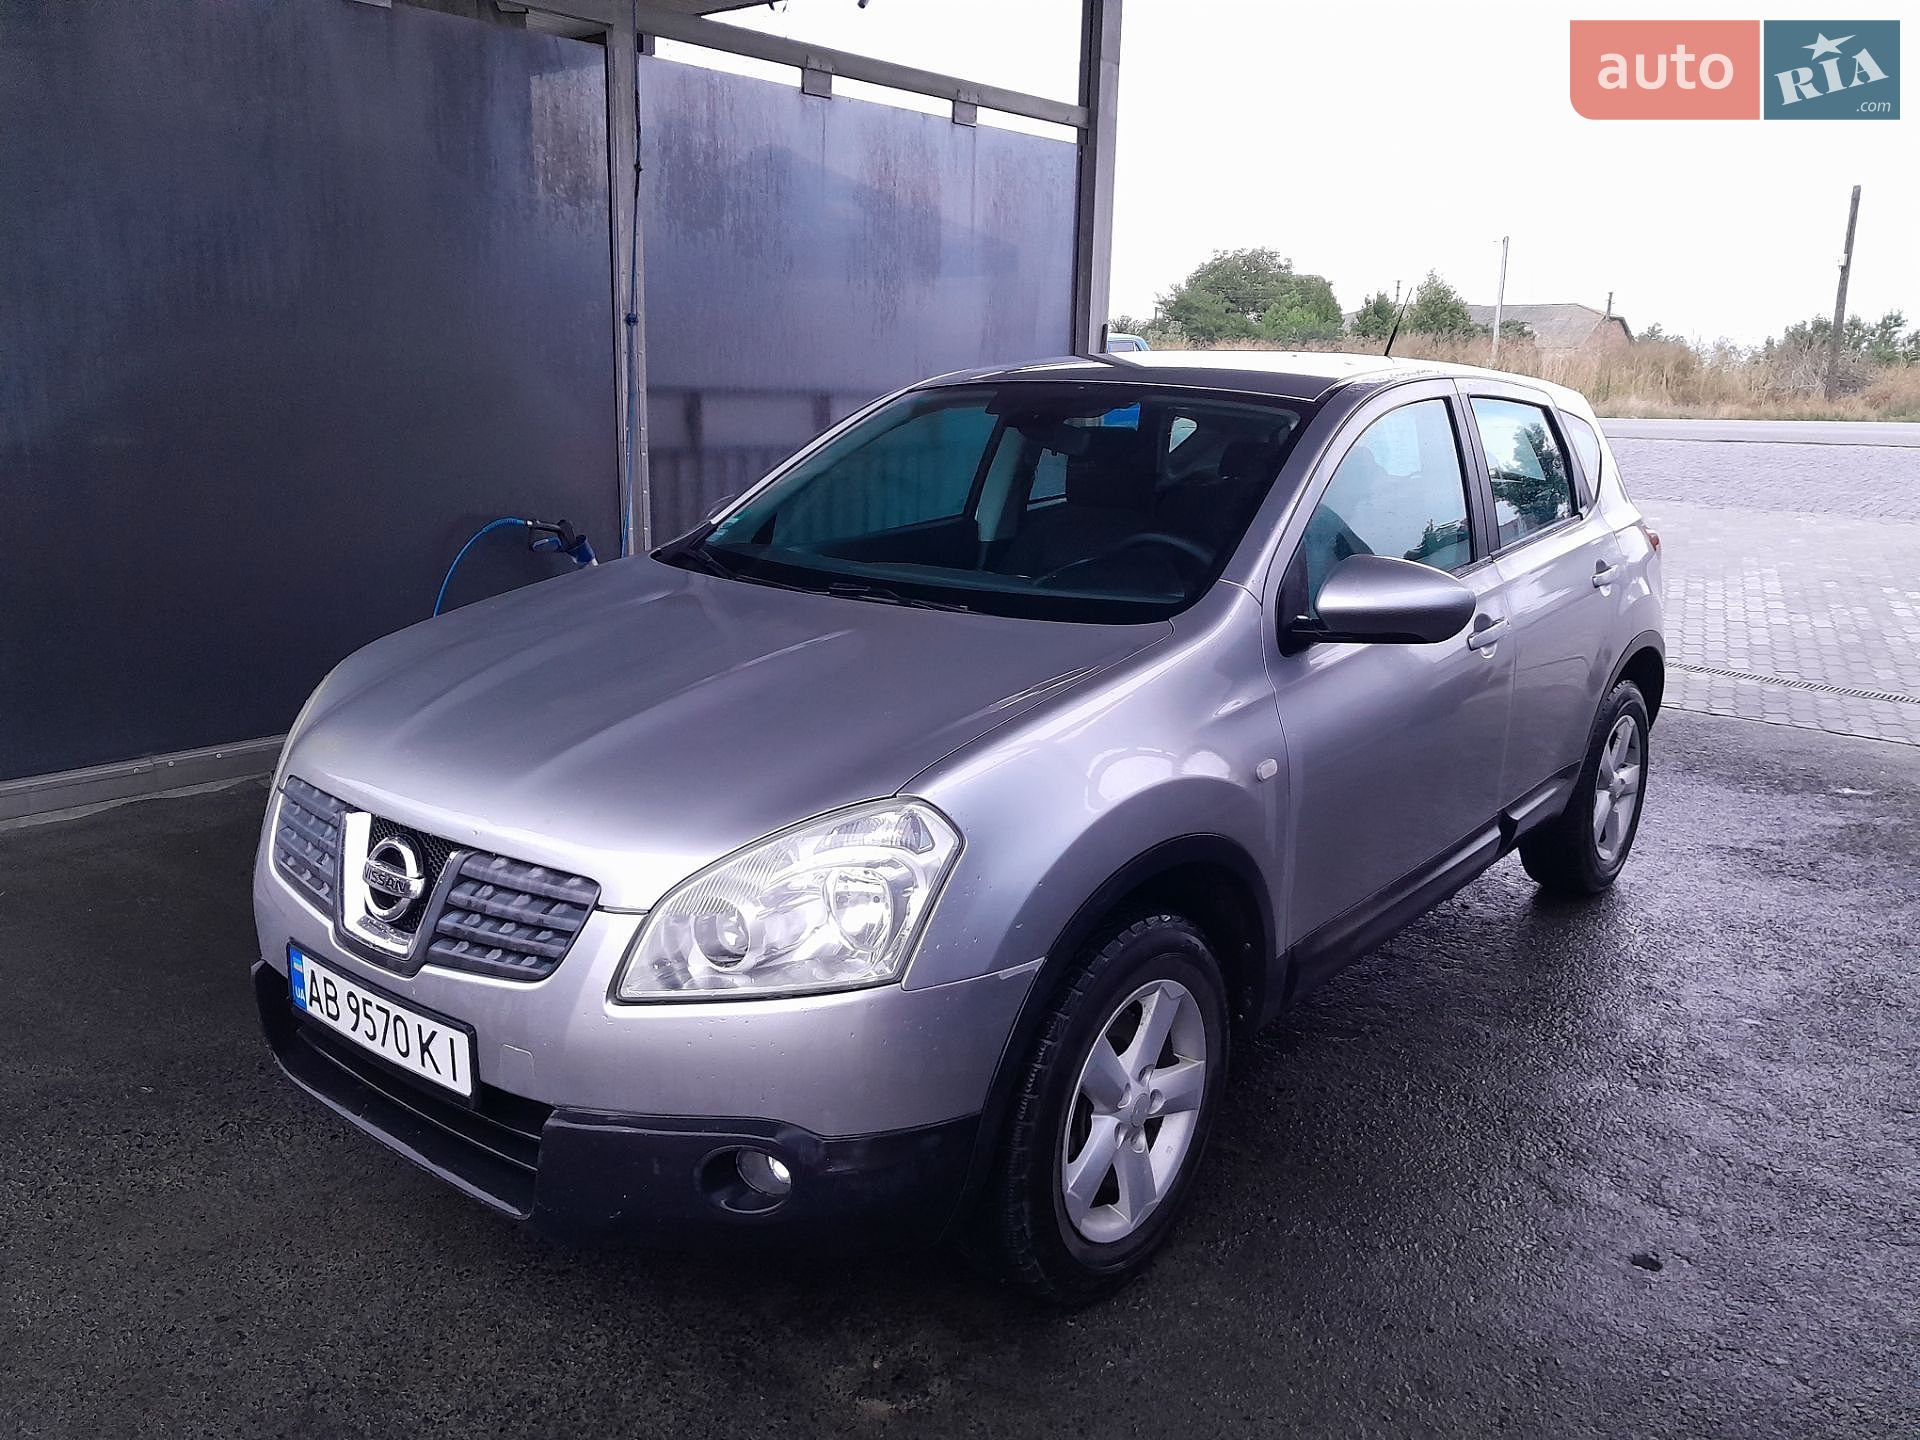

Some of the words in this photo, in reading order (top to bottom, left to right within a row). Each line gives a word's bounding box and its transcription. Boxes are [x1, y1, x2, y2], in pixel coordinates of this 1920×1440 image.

[364, 863, 408, 893] NISSAN
[295, 985, 305, 1001] UA
[309, 969, 340, 1022] AB
[346, 990, 410, 1058] 9570
[417, 1023, 457, 1082] KI
